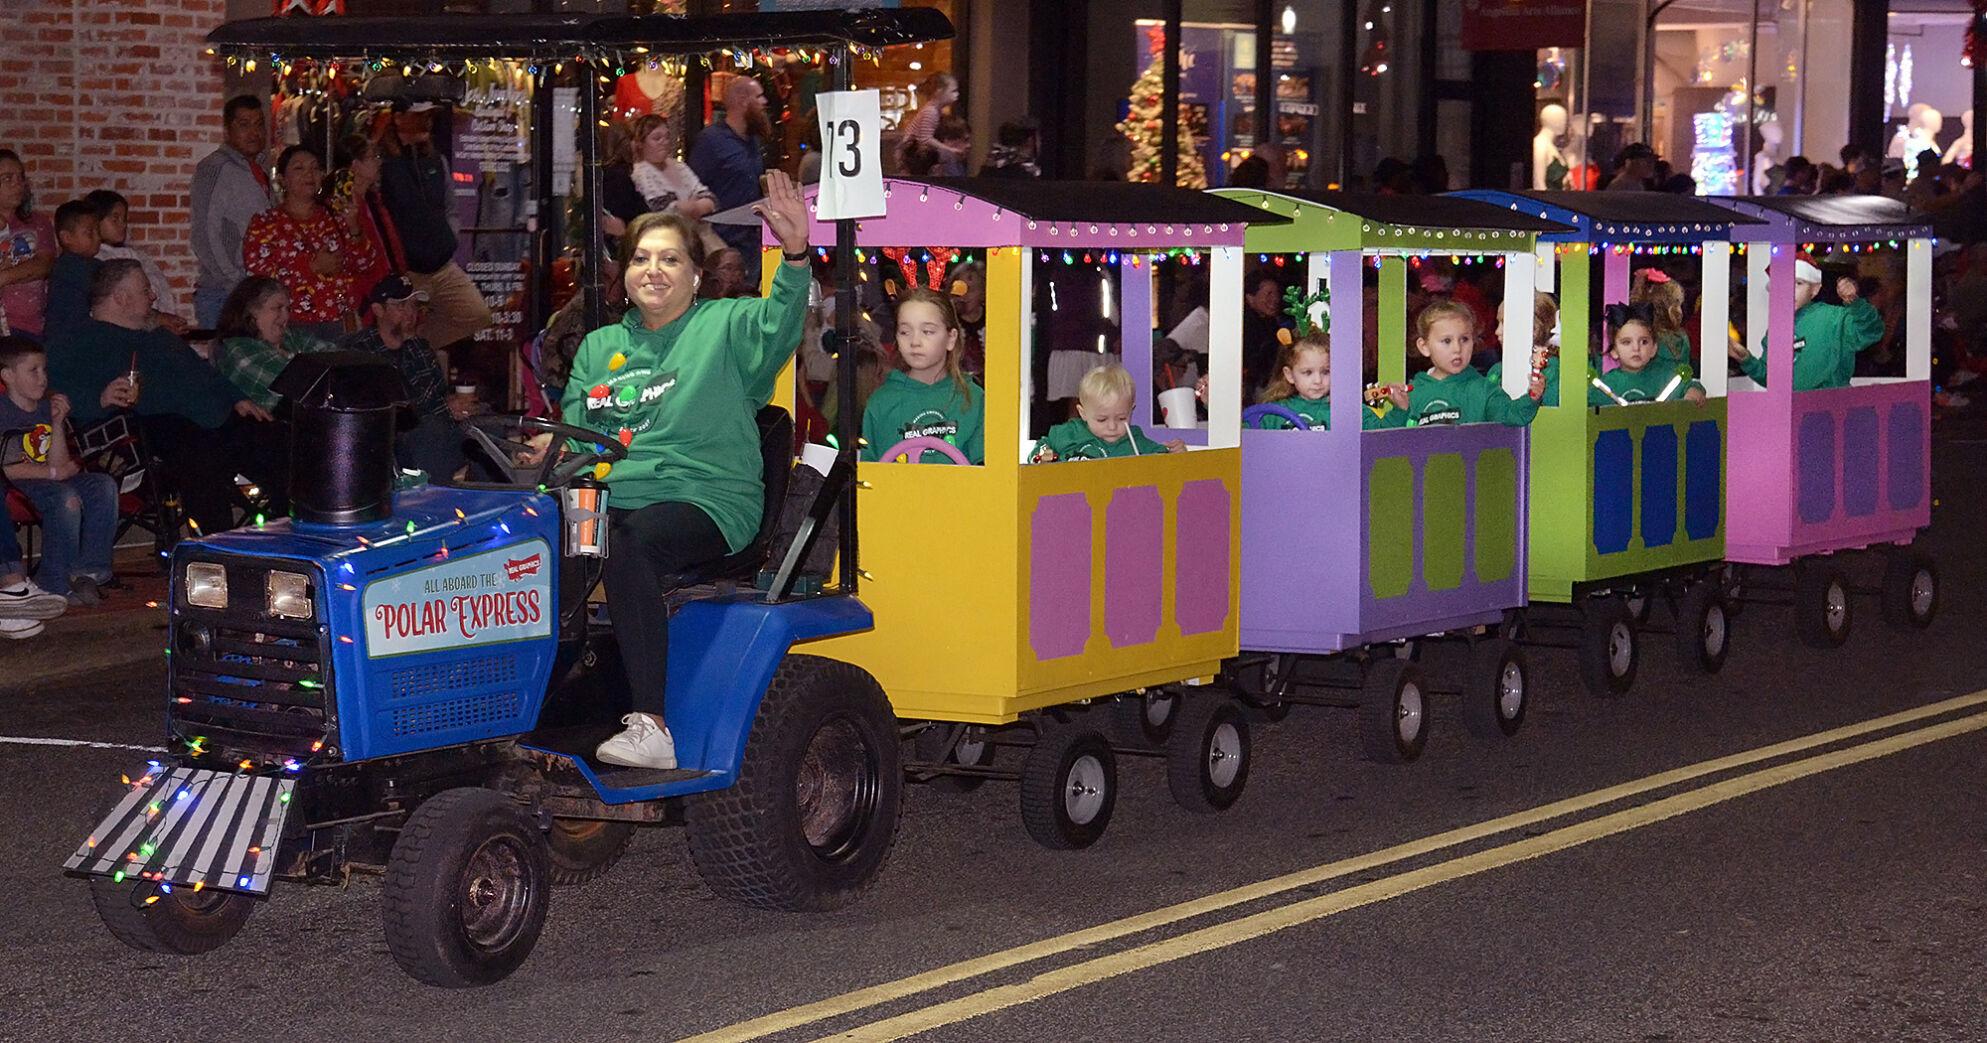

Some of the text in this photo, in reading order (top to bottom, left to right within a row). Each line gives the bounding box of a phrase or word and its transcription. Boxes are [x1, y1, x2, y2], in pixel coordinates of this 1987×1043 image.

[904, 430, 921, 439] REAL
[424, 572, 497, 594] ALL ABOARD THE
[375, 588, 541, 640] POLAR EXPRESS
